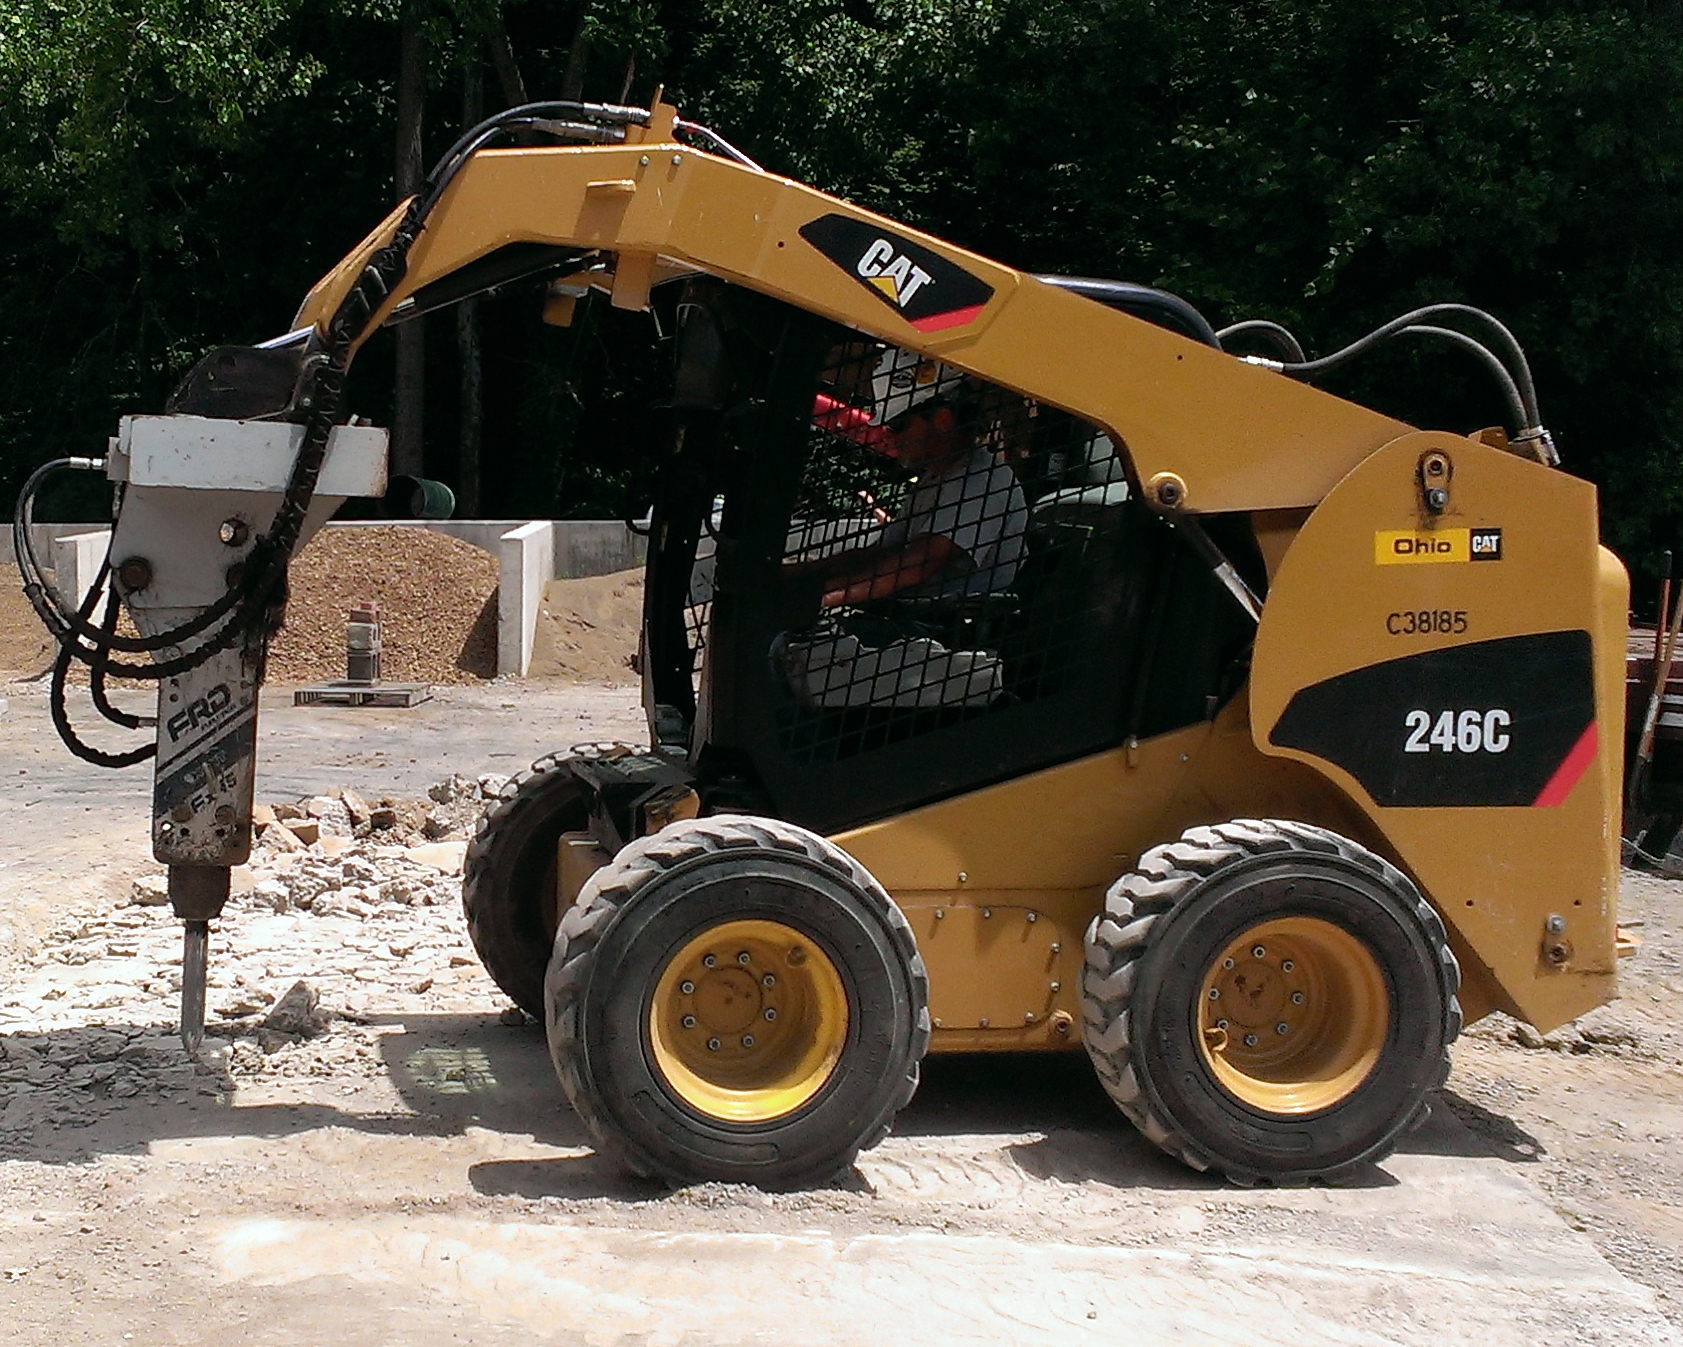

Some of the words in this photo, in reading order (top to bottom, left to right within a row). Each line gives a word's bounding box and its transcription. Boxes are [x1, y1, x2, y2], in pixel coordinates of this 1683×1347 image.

[857, 238, 932, 308] CAT
[1394, 538, 1452, 554] Ohio
[1472, 535, 1499, 553] CAT
[1386, 610, 1468, 635] C38185
[166, 683, 232, 743] FRD
[1404, 709, 1511, 753] 246C
